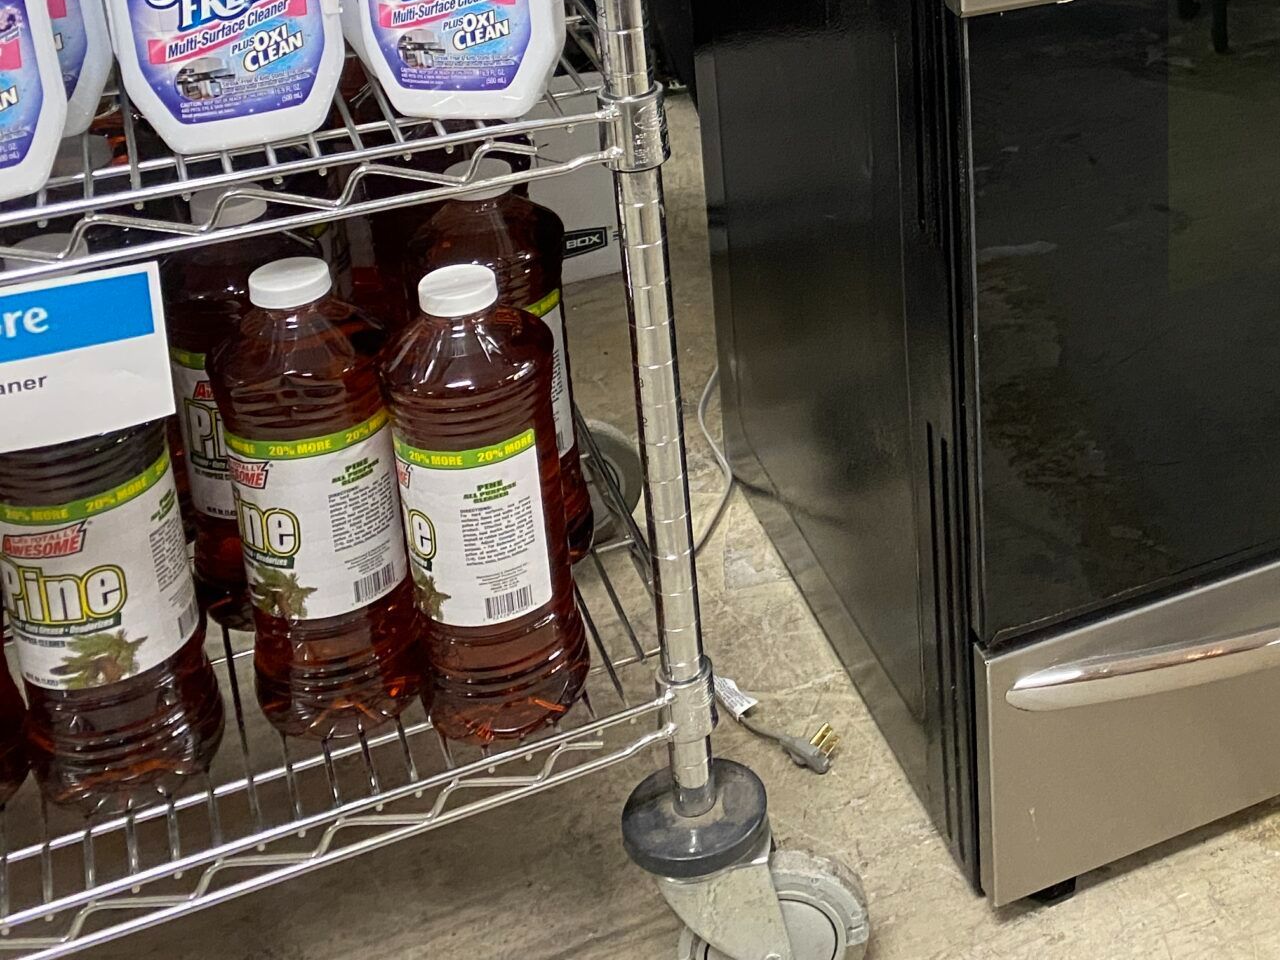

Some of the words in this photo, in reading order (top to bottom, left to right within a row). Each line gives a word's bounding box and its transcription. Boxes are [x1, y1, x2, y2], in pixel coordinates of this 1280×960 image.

[442, 16, 464, 32] PLUS
[463, 10, 496, 32] OXI
[167, 18, 246, 59] Multi-Surface
[231, 38, 255, 55] PLUS
[253, 24, 289, 51] OXI
[452, 19, 510, 51] CLEAN
[244, 31, 303, 73] CLEAN
[268, 445, 295, 457] 20%
[296, 439, 333, 455] MORE
[408, 450, 430, 464] 20%
[430, 454, 464, 466] MORE
[477, 448, 503, 463] 20%
[504, 434, 534, 455] MORE
[116, 476, 149, 502] MORE
[476, 479, 503, 492] PINE
[3, 533, 80, 556] AWESOME
